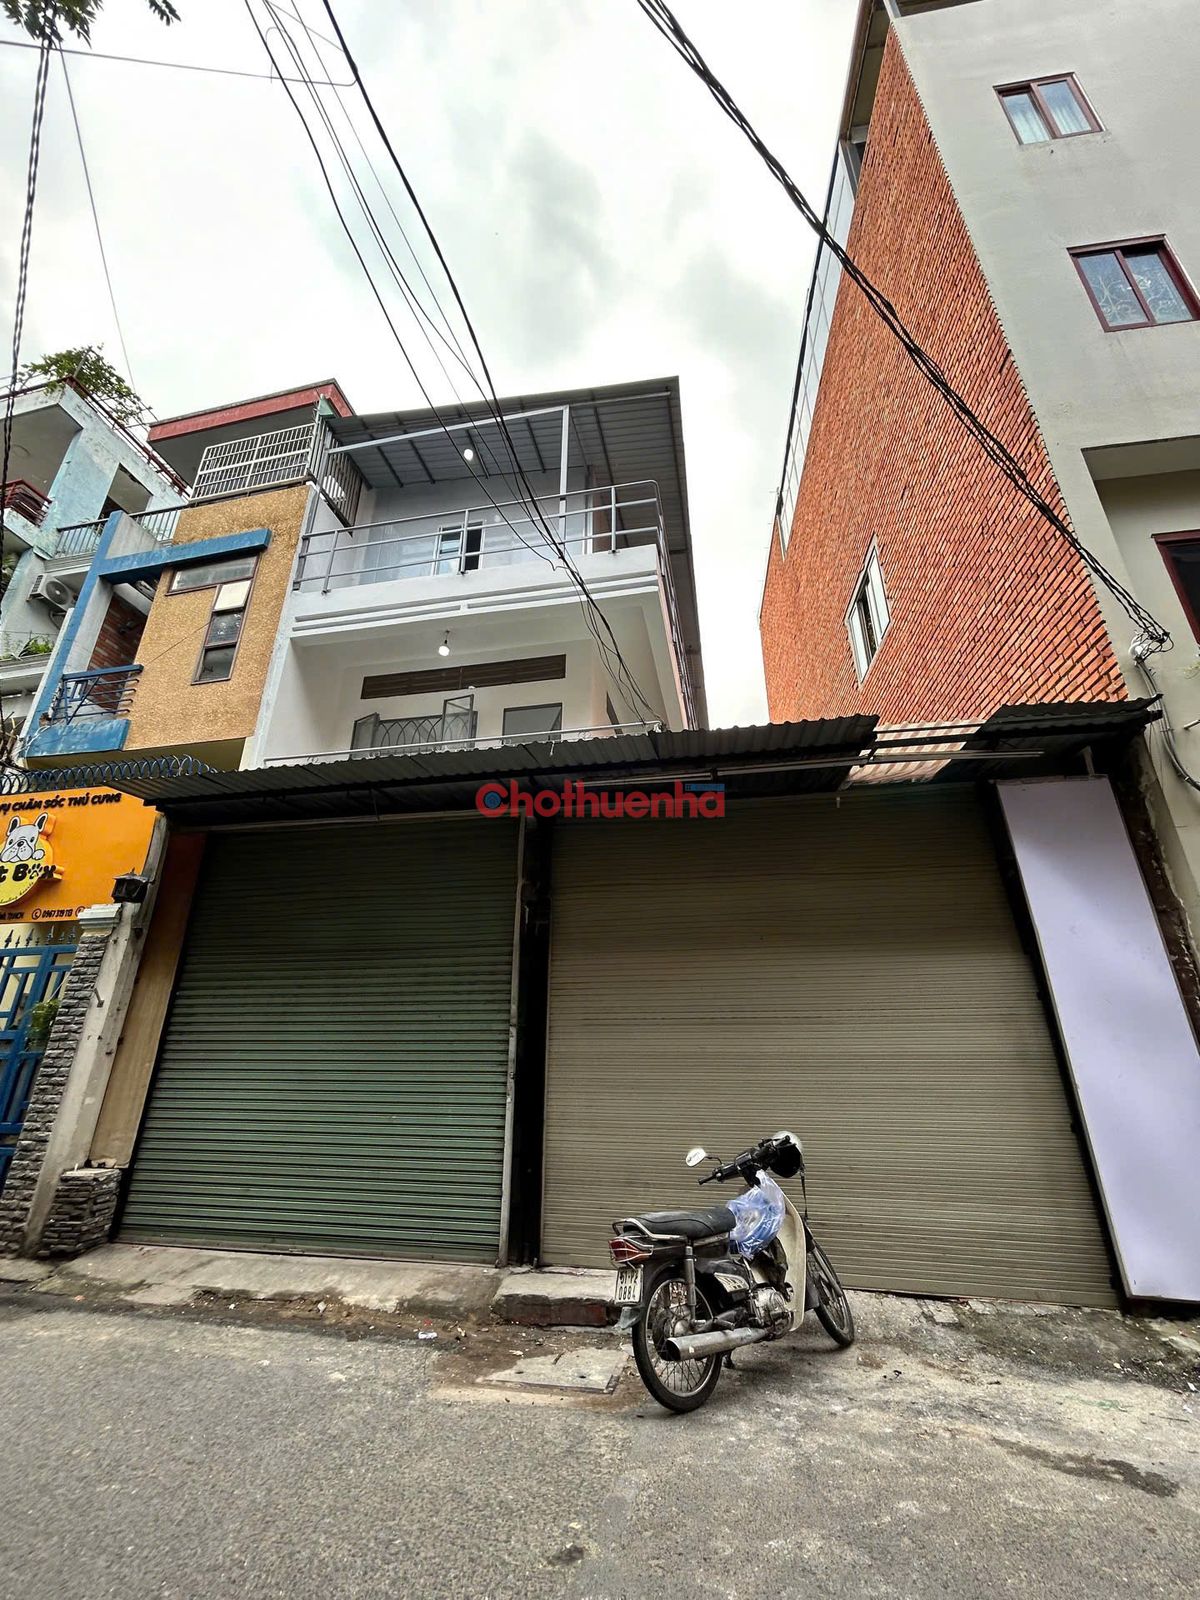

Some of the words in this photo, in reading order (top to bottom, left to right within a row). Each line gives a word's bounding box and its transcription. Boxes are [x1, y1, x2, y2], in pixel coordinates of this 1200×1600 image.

[12, 798, 43, 812] CHĂM
[43, 794, 66, 808] SÓC
[67, 792, 90, 807] THÚ
[91, 792, 122, 805] CƯNG
